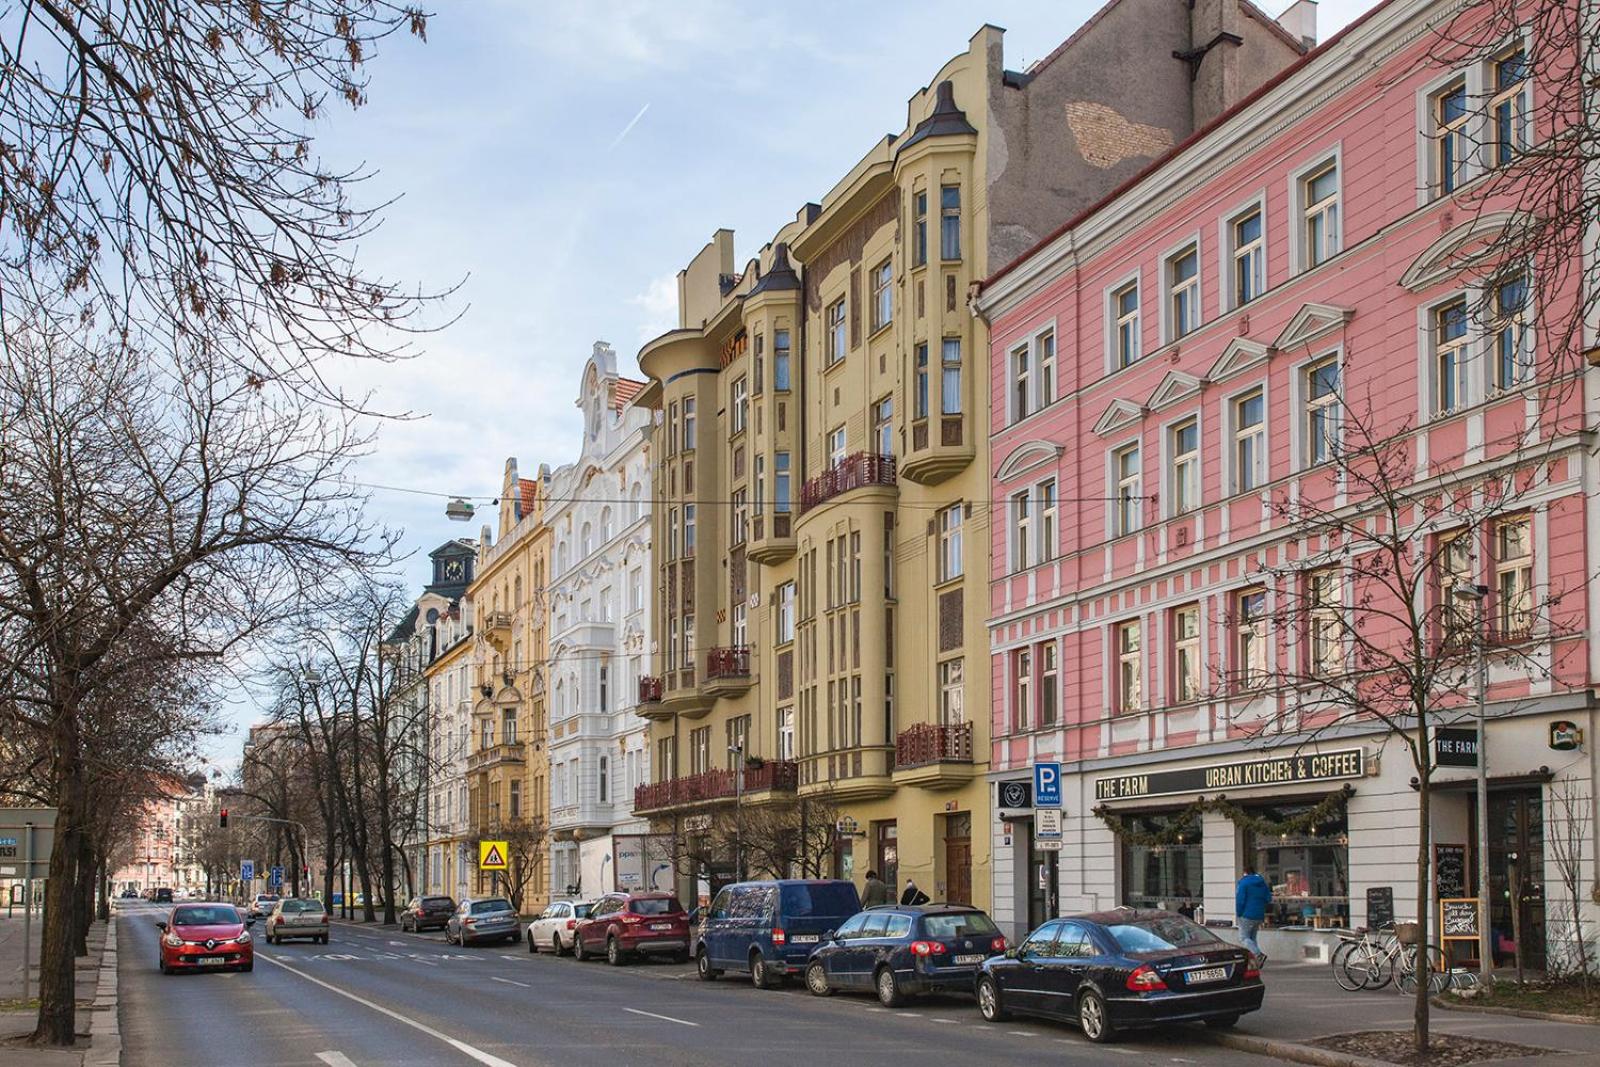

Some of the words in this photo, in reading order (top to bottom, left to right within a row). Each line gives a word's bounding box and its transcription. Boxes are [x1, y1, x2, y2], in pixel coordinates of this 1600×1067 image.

[1437, 740, 1453, 753] THE
[1040, 768, 1055, 792] P
[1205, 766, 1241, 788] URBAN
[1245, 761, 1292, 784] KITCHEN
[1297, 759, 1307, 779] &
[1311, 753, 1358, 778] COFFEE
[1097, 779, 1116, 798] THE
[1119, 775, 1148, 796] FARM
